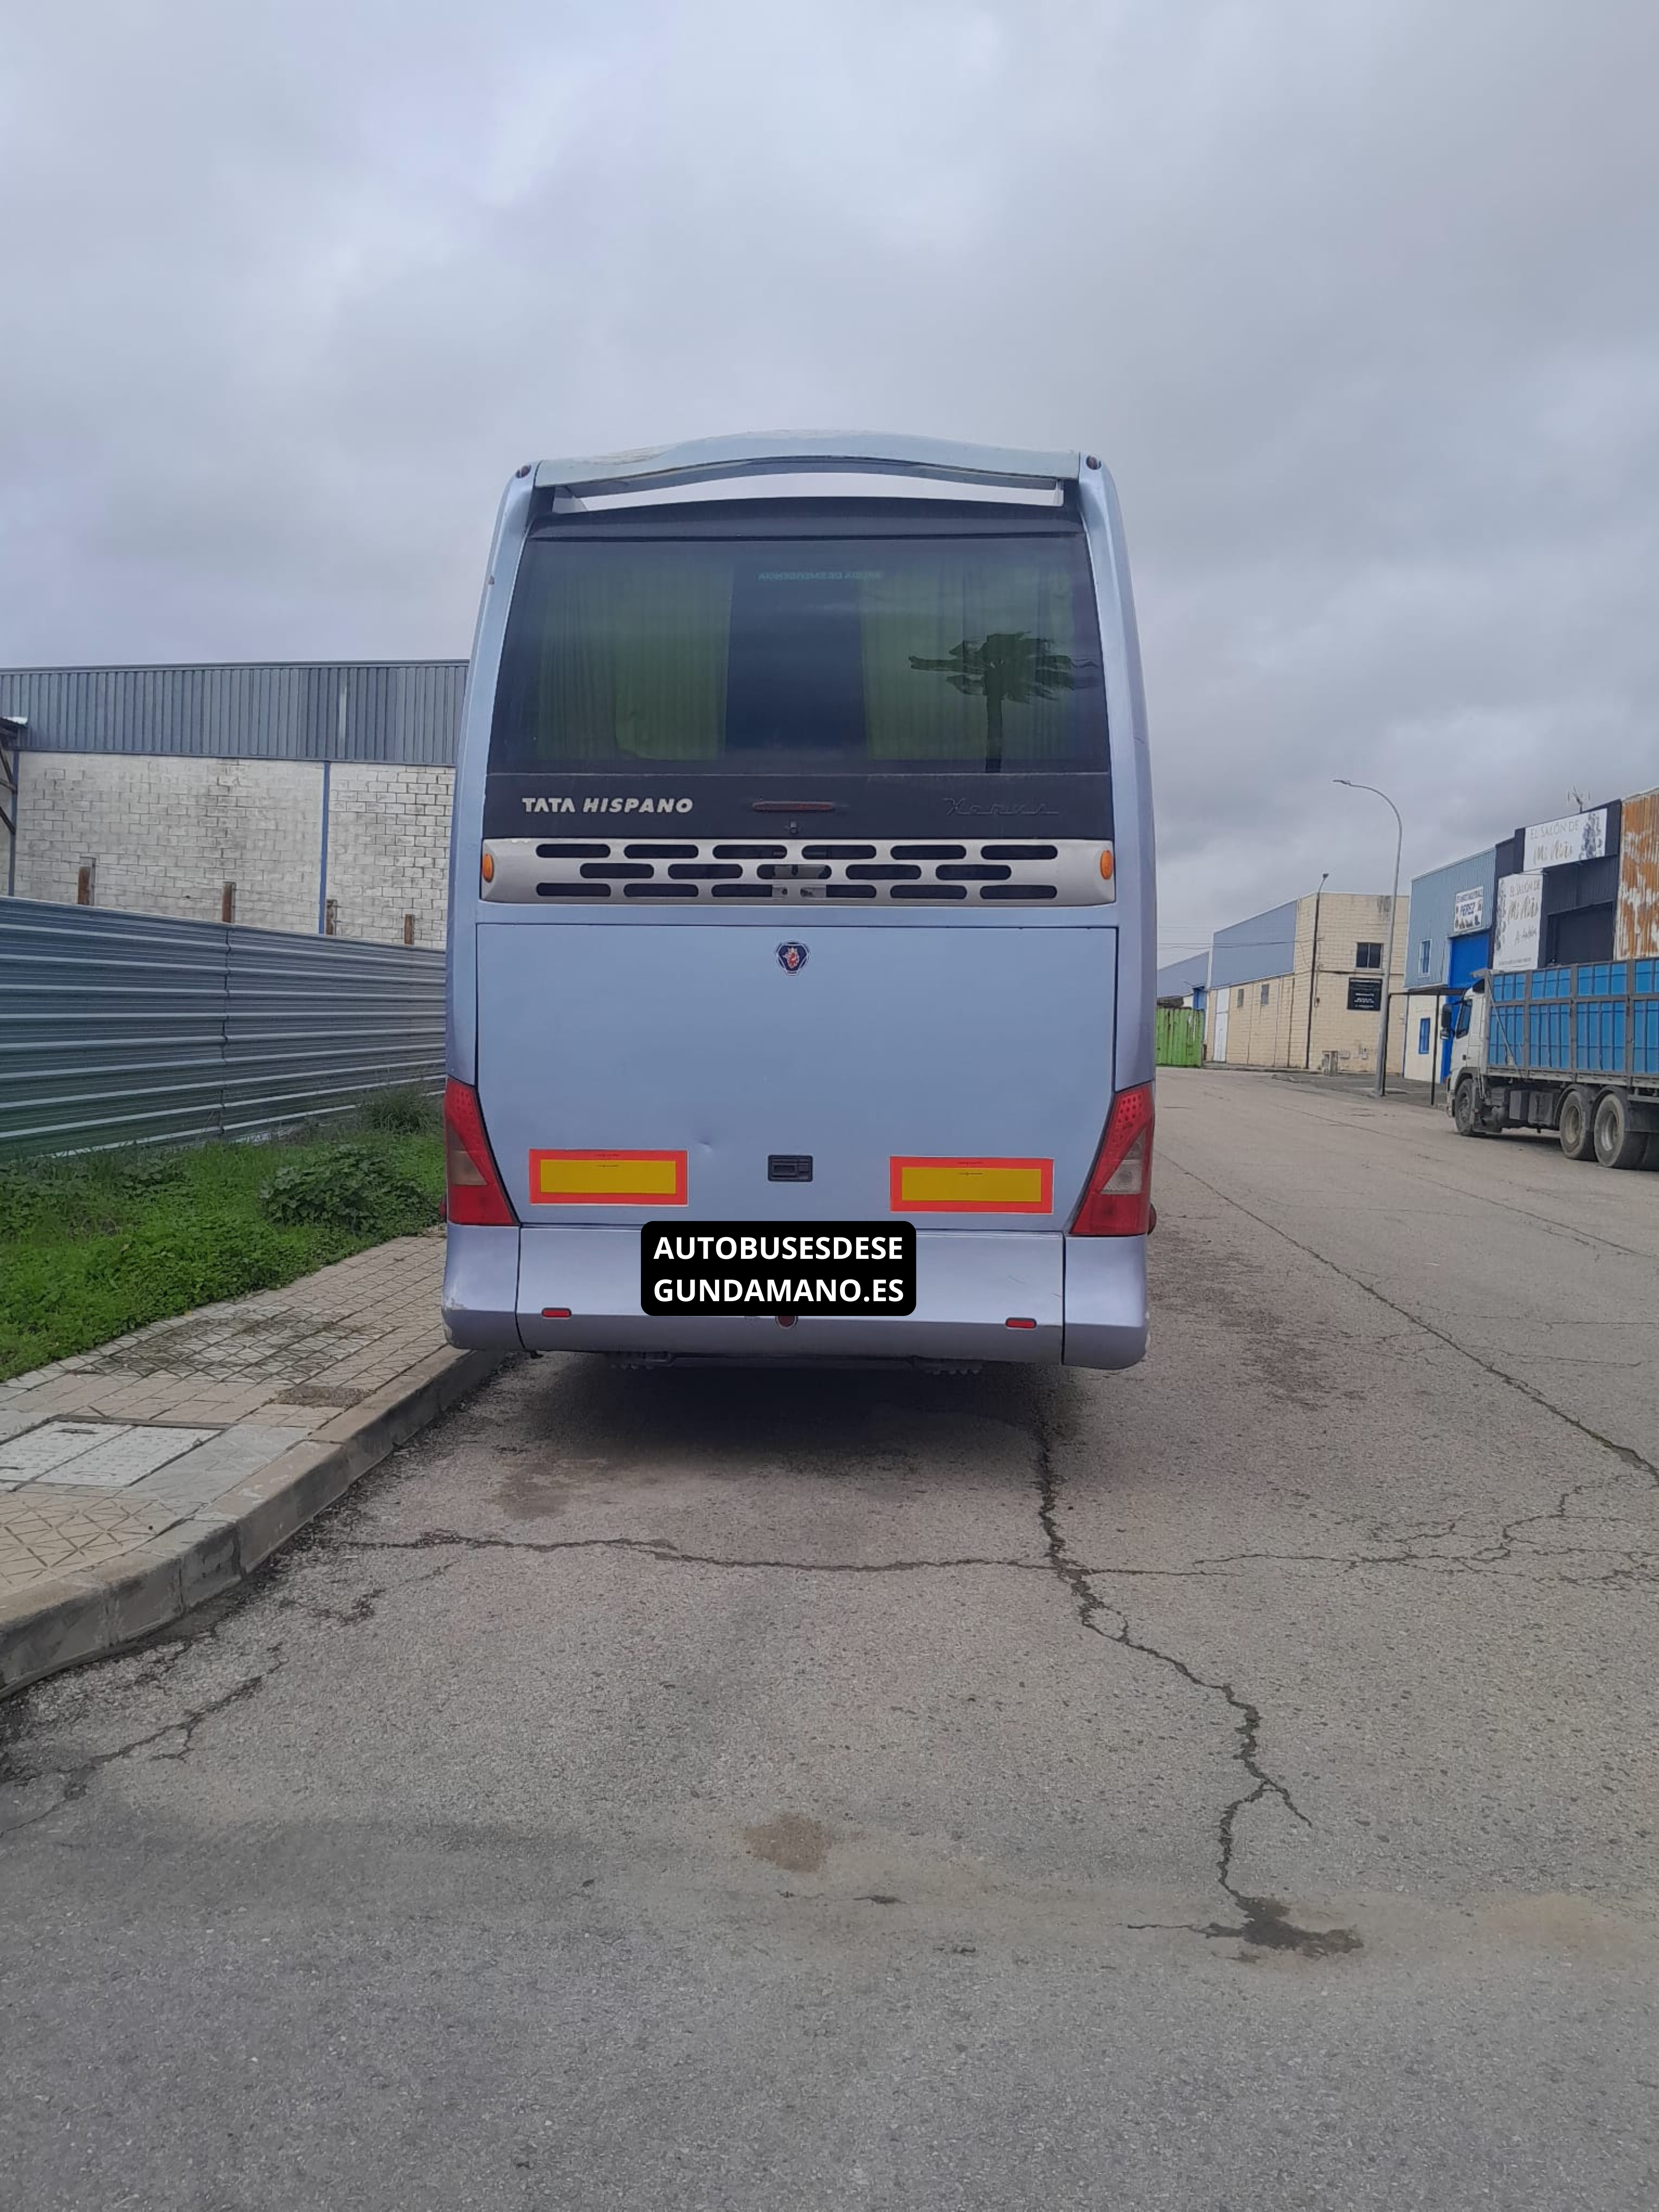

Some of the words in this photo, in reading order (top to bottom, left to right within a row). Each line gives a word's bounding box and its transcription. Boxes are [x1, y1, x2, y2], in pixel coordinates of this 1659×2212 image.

[522, 798, 575, 812] TATA
[583, 798, 694, 813] HISPANO
[1530, 828, 1538, 839] EL
[1541, 822, 1566, 837] SALÓN
[1569, 819, 1579, 832] DE
